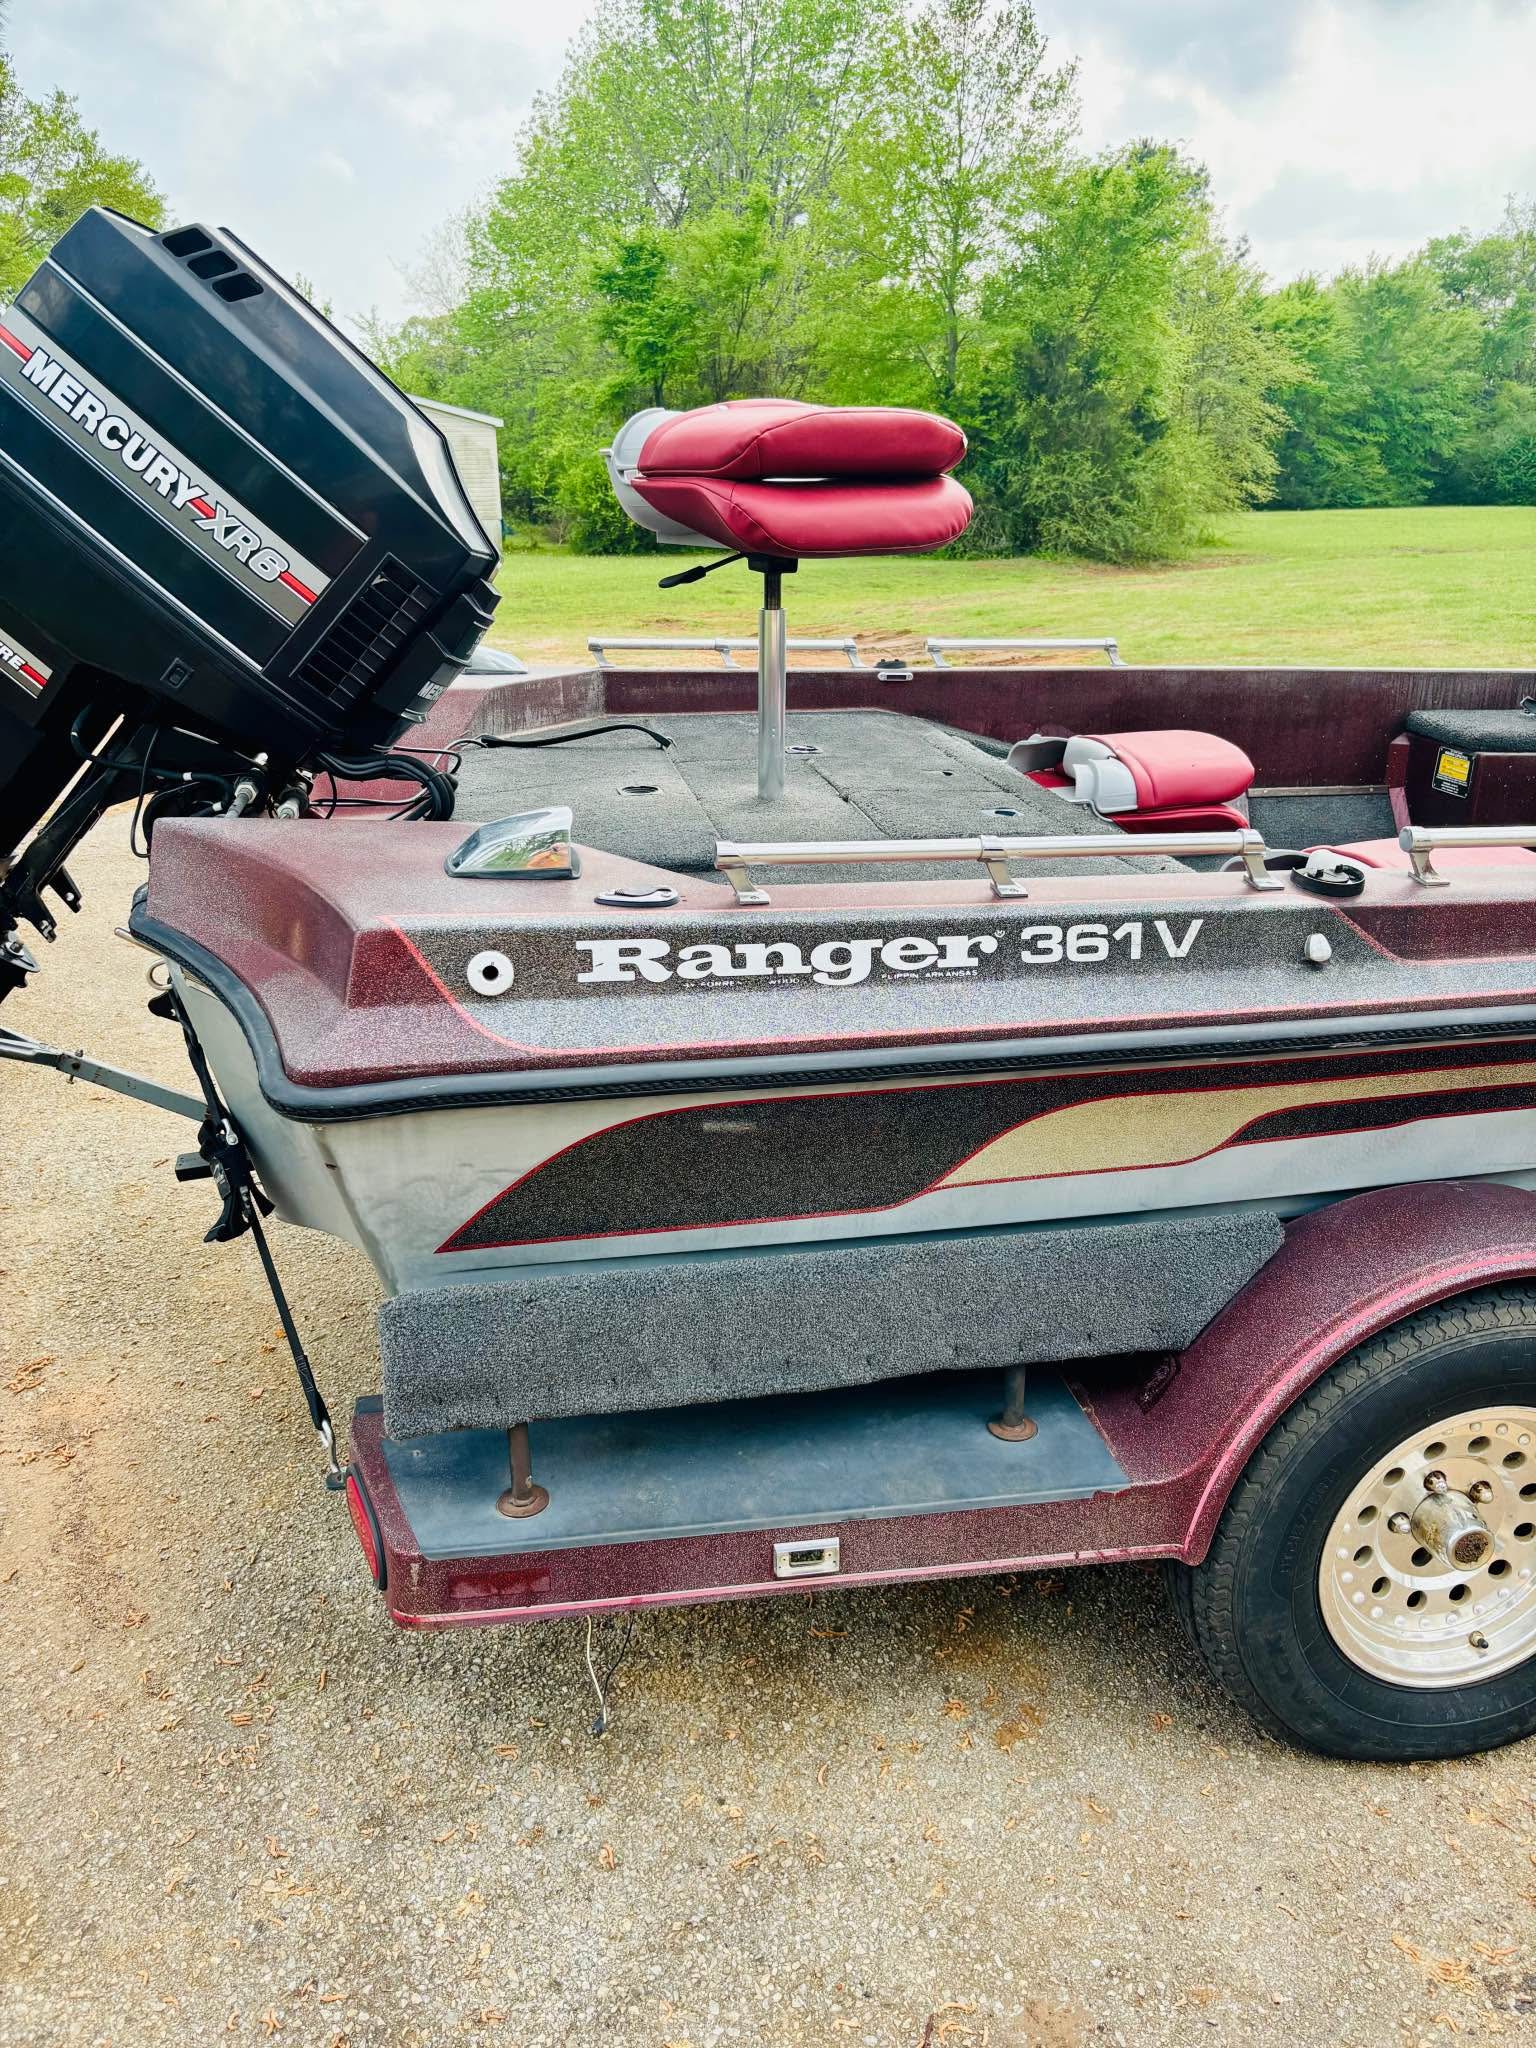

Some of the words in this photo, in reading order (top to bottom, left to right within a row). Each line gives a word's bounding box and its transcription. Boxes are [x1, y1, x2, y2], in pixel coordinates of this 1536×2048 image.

[20, 347, 207, 511] MERCURY
[194, 501, 290, 582] XR6
[0, 641, 27, 670] RE
[576, 935, 999, 986] Ranger
[925, 969, 978, 978] ARKANSAS
